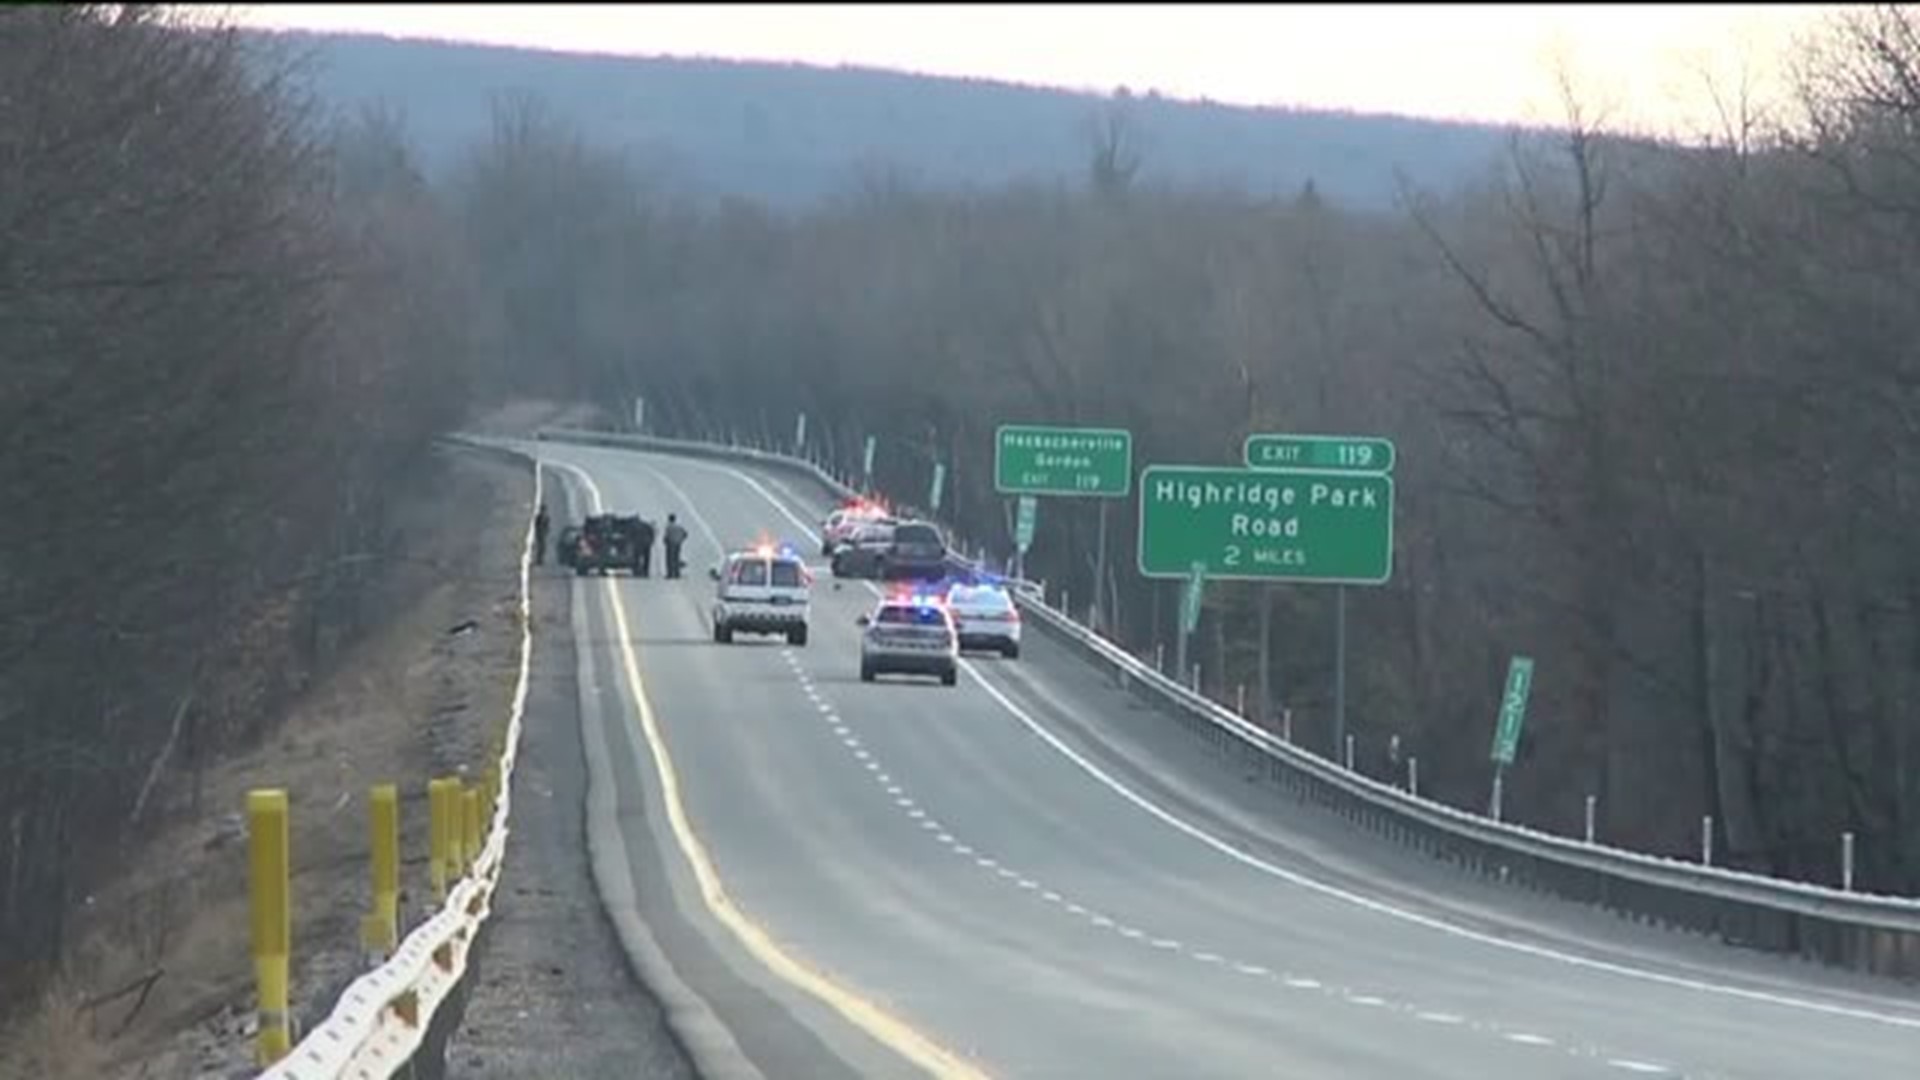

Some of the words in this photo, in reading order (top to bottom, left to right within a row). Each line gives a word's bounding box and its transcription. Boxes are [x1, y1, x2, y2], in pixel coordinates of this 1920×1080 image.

[1261, 446, 1300, 460] EXIT
[1338, 445, 1373, 466] 119
[1156, 480, 1296, 511] Highridge
[1310, 483, 1377, 508] Park
[1231, 514, 1299, 537] Road
[1223, 545, 1241, 565] 2
[1253, 548, 1306, 565] MILES
